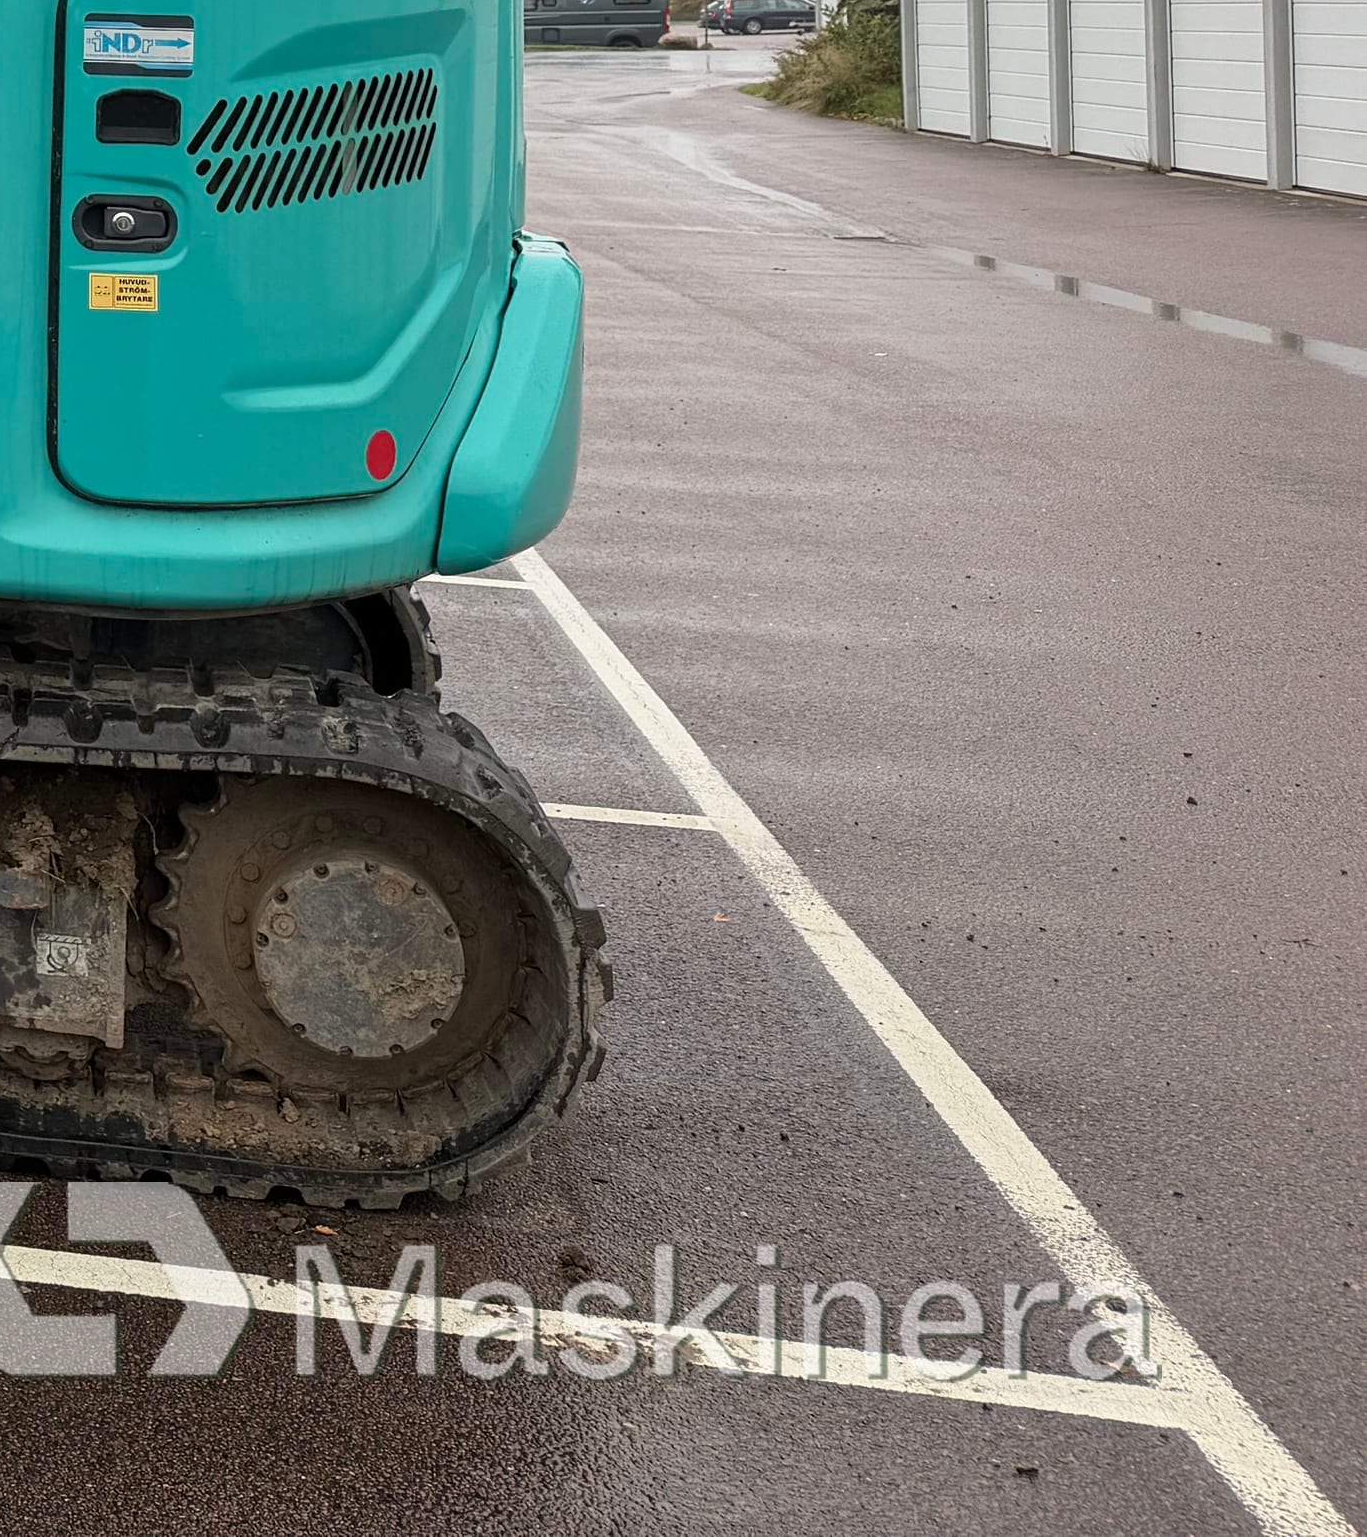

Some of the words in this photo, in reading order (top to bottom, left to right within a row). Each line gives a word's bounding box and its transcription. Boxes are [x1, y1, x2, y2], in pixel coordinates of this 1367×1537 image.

[119, 278, 151, 286] HUVUD-
[118, 286, 152, 294] STRÖM-
[116, 295, 154, 303] BRYTARE
